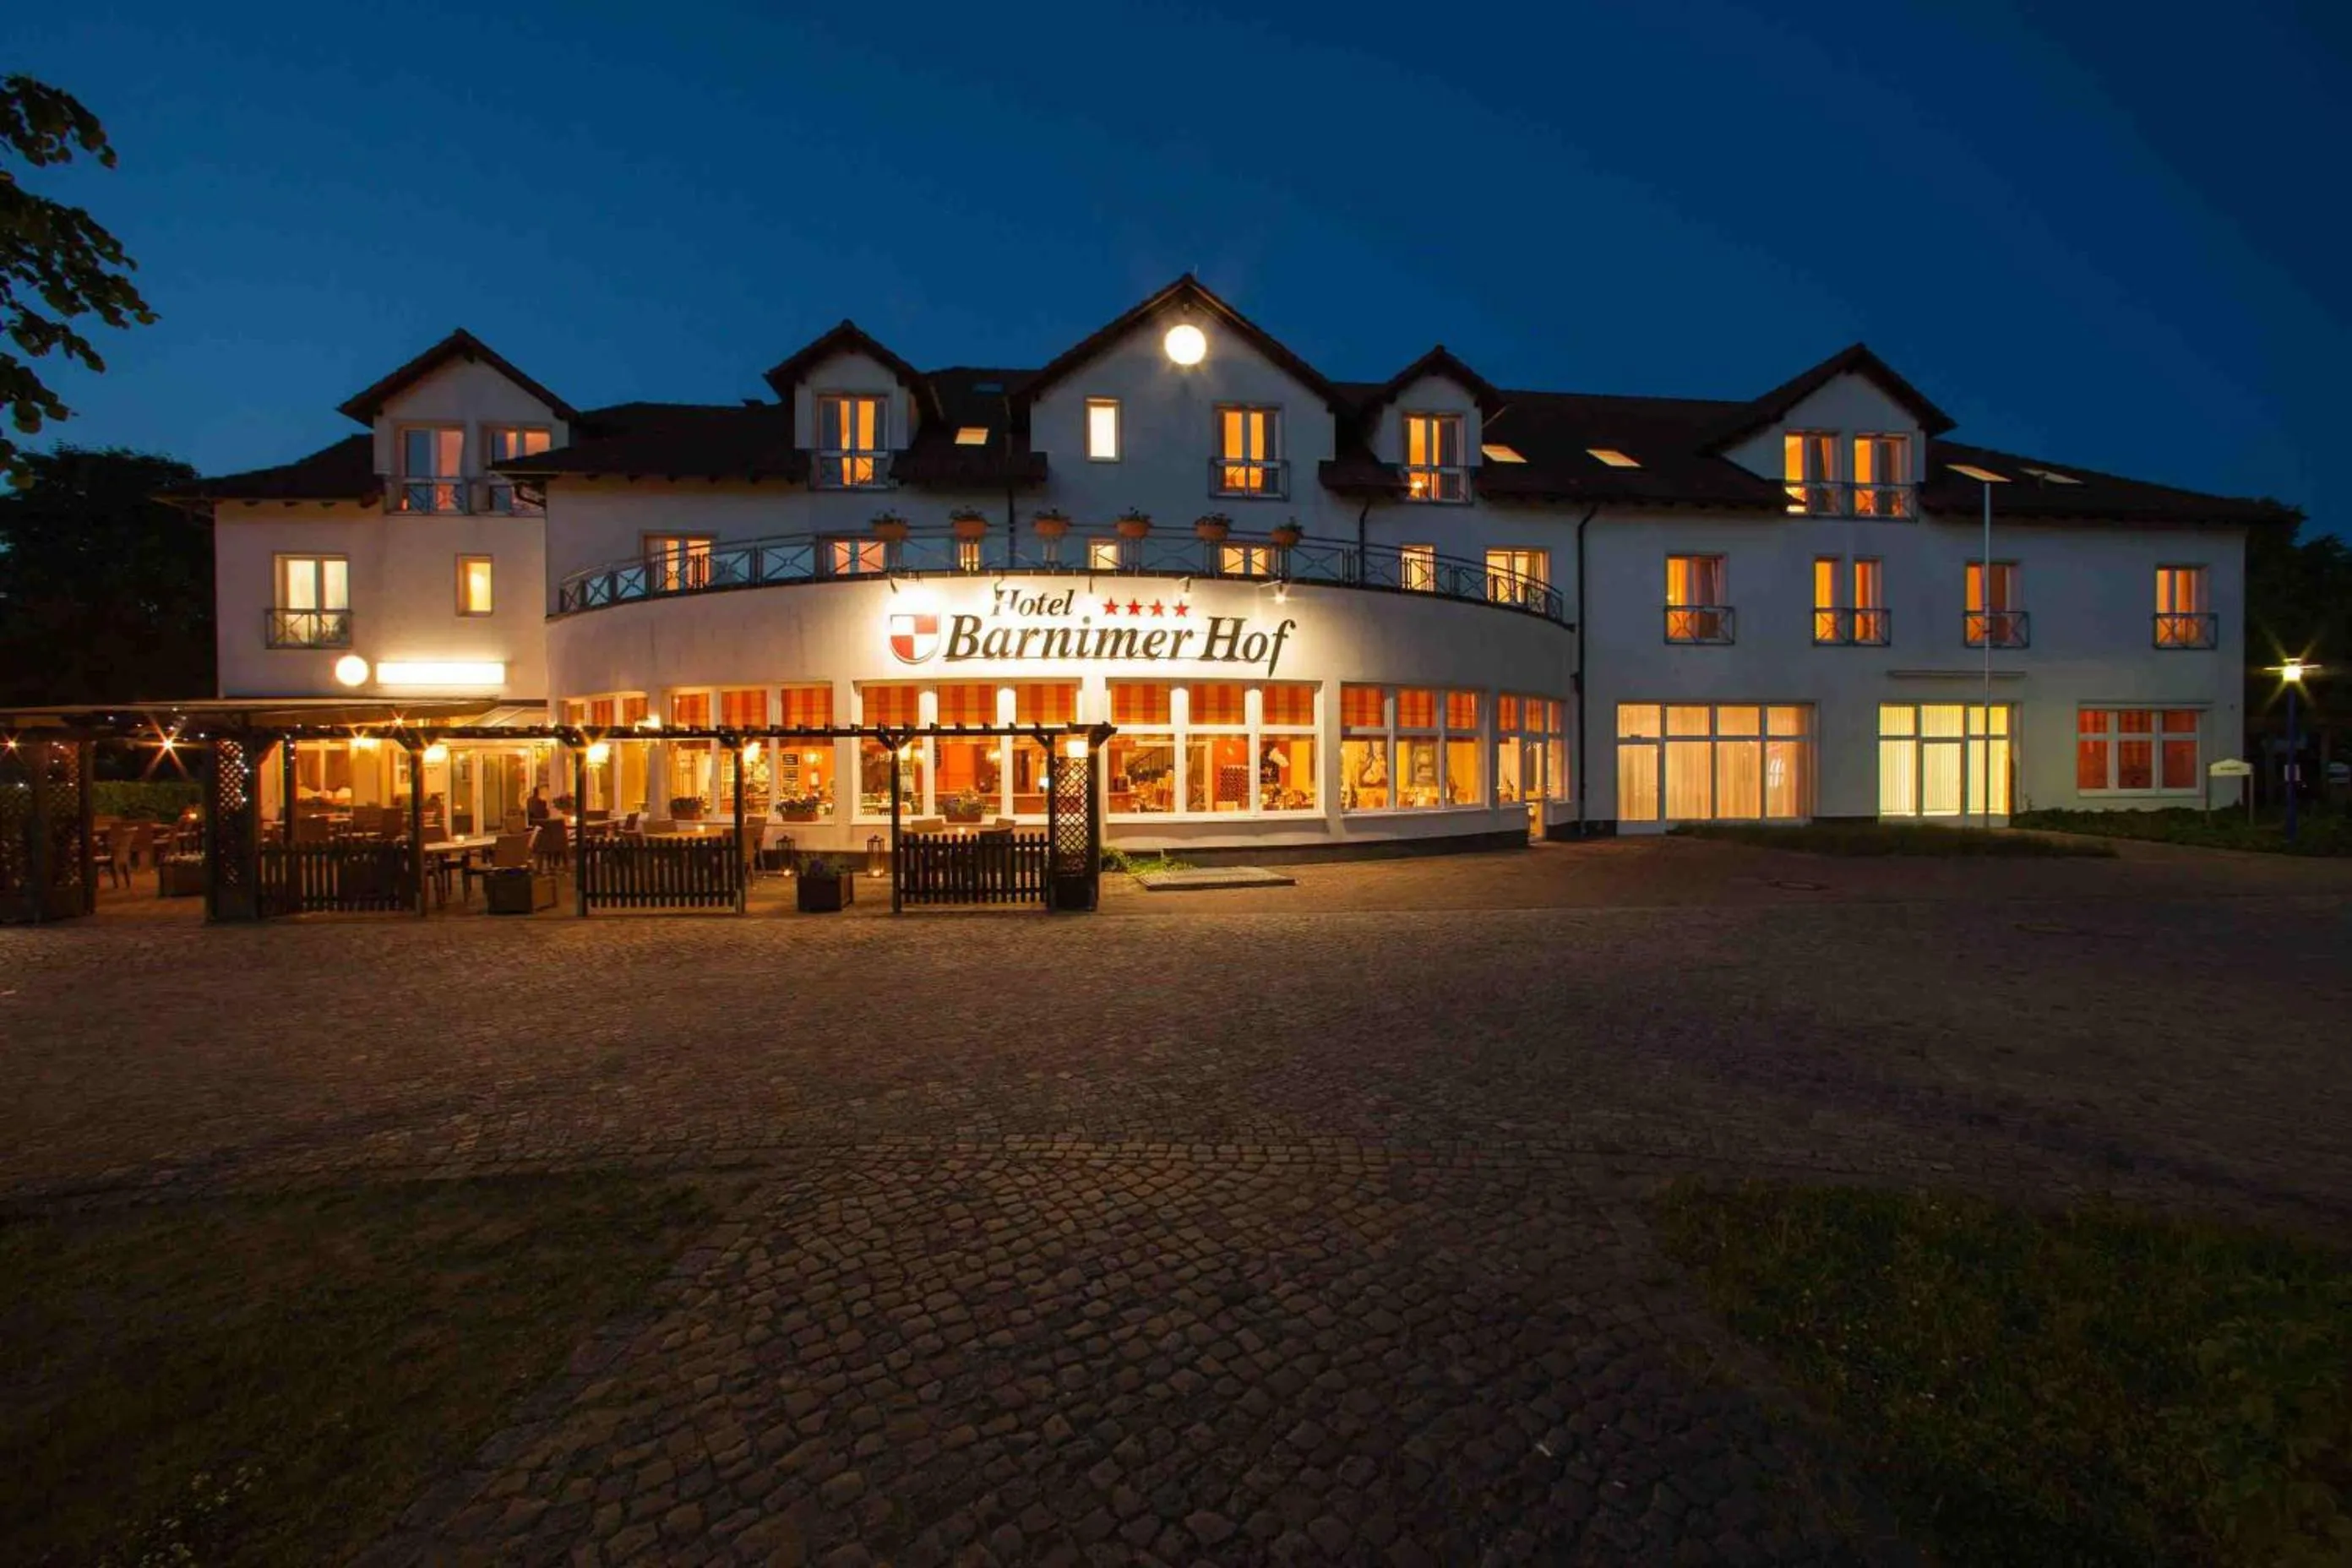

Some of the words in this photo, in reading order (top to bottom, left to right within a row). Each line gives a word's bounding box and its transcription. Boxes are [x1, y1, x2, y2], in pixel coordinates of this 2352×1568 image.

[990, 589, 1075, 616] Hotel
[944, 614, 1193, 662] Barnimer
[1198, 617, 1296, 678] Hof
